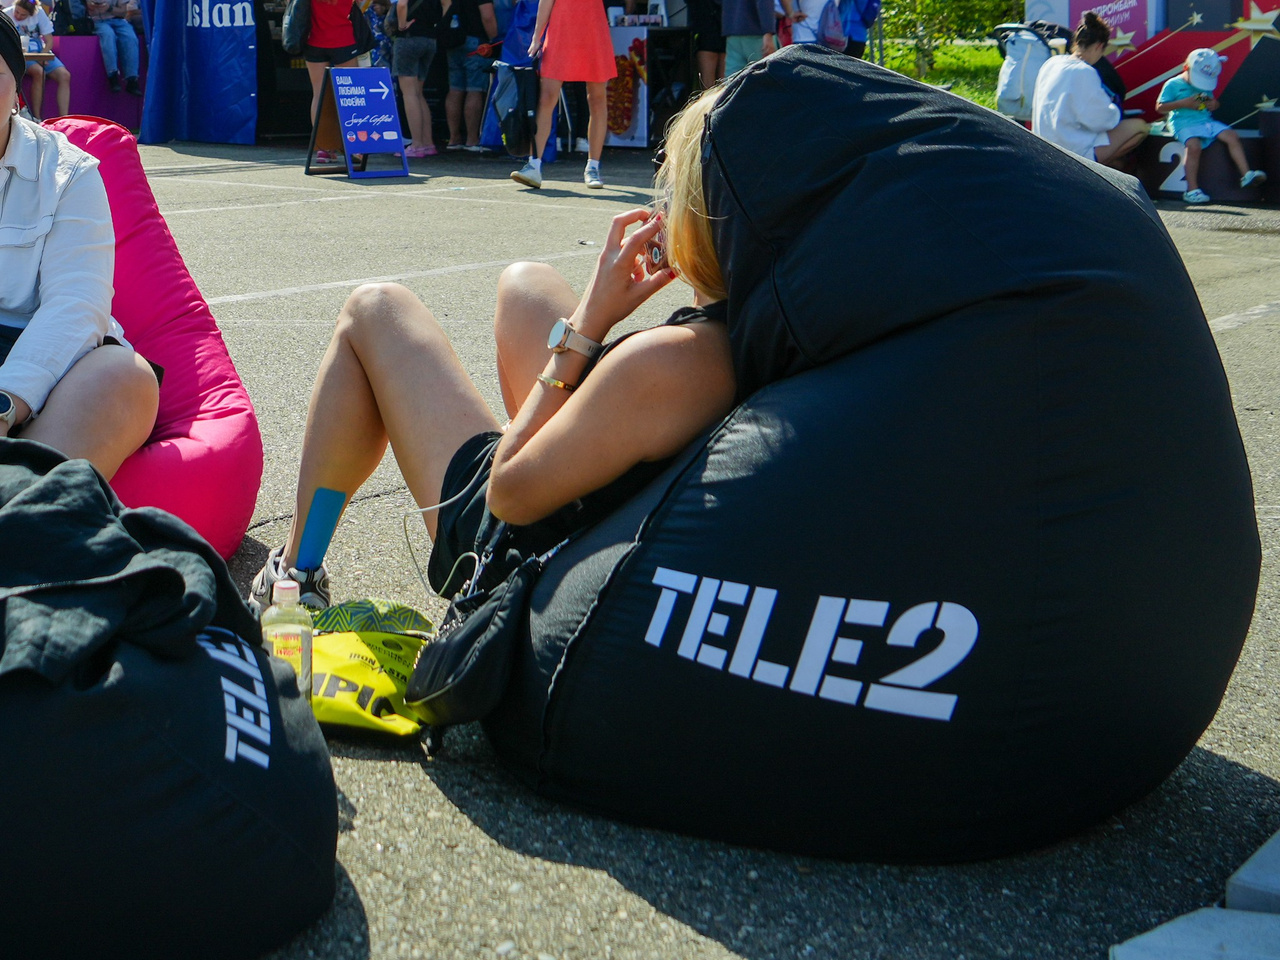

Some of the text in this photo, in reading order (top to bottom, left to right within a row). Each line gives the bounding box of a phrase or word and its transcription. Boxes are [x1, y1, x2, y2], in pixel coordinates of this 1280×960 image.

[335, 76, 353, 85] ВАША
[338, 86, 366, 95] ЛЮБИМАЯ
[340, 96, 367, 107] КОФЕЙНЯ
[1159, 141, 1188, 192] 2
[644, 566, 979, 721] TELE2
